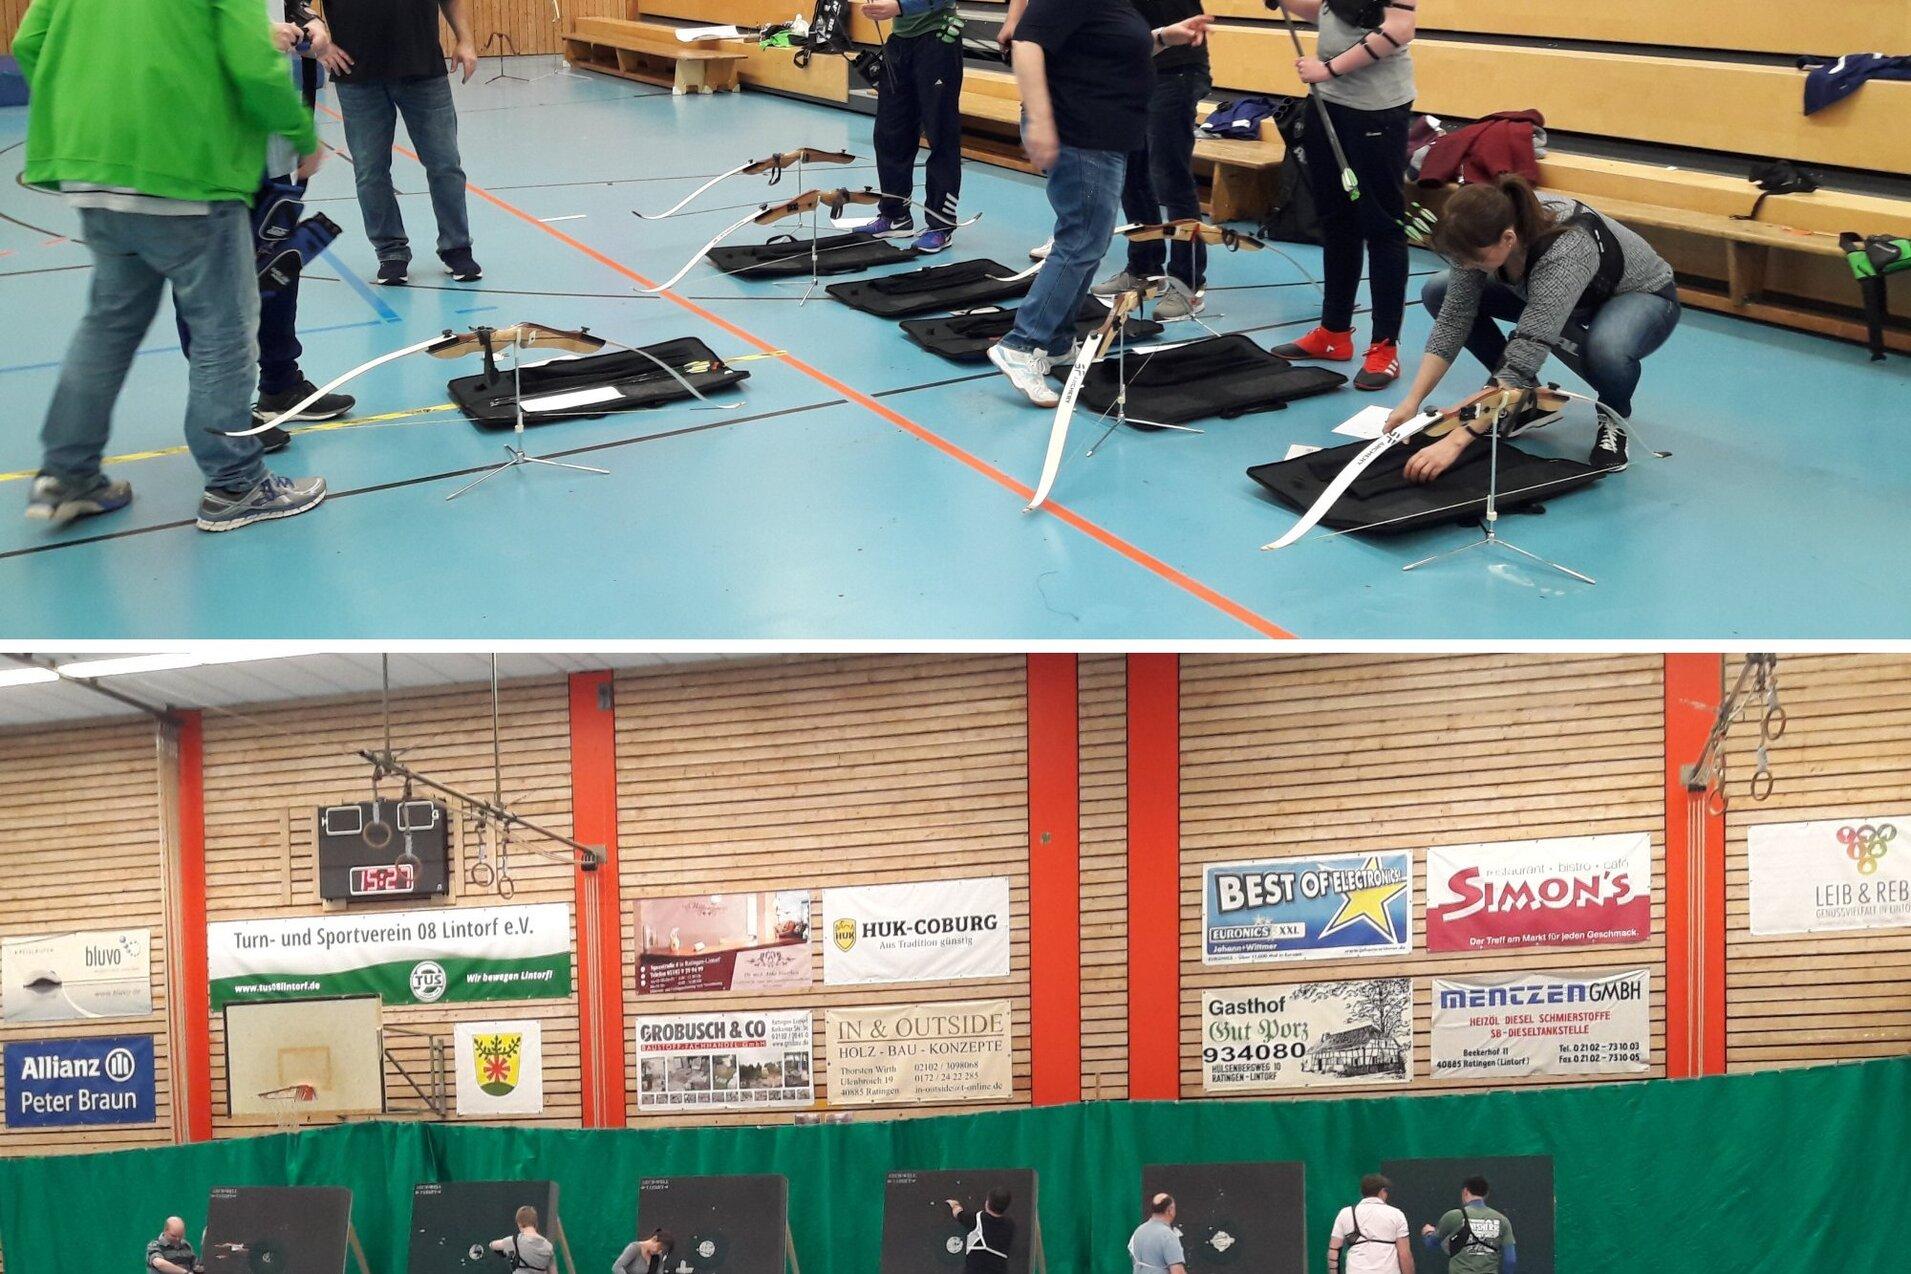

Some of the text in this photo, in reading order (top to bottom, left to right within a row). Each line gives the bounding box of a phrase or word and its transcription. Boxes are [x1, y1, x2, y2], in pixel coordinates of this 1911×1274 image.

[1558, 862, 1592, 873] bistro
[361, 867, 411, 892] 15:27
[1216, 872, 1296, 914] BEST
[1301, 870, 1330, 899] OF
[1816, 883, 1852, 907] LEIB
[1858, 882, 1871, 904] &
[234, 916, 534, 950] Turn- und Sportverein 08 Lintorf e.V.
[862, 914, 998, 938] HUK-COBURG
[1212, 924, 1300, 941] EURONICS XXL
[835, 930, 855, 941] HUK
[879, 936, 973, 950] Aus Tradition günstig
[1469, 937, 1485, 946] Der
[1486, 935, 1505, 944] Treff
[1522, 934, 1547, 943] Markt
[1548, 933, 1560, 941] für
[1561, 931, 1585, 942] jeden
[85, 944, 122, 967] bluvo
[415, 974, 442, 986] TUS
[467, 973, 482, 983] Wir
[483, 972, 520, 983] bewegen
[235, 981, 321, 993] www.tus08lintorf.de
[1589, 980, 1641, 1002] GMBH
[1209, 996, 1286, 1016] Gasthof
[1505, 1014, 1534, 1025] DIESEL
[1539, 1010, 1611, 1023] SCHMIERSTOFFE
[640, 1020, 766, 1042] GROBUSCH & CO
[839, 1013, 1003, 1040] IN & OUTSIDE
[1209, 1021, 1252, 1042] Gut
[839, 1046, 876, 1059] HOLZ
[888, 1044, 917, 1056] BAU
[929, 1040, 1003, 1055] KONZEPTE
[1203, 1042, 1306, 1063] 934080
[1463, 1047, 1500, 1057] Beekerhof
[1559, 1044, 1572, 1052] Tel.
[21, 1055, 101, 1080] Allianz
[914, 1063, 938, 1071] 02102
[1436, 1057, 1530, 1069] 40885 Ratingen (Lintorf)
[841, 1067, 873, 1076] Thorsten
[914, 1073, 933, 1082] 0172
[885, 1076, 894, 1084] 19
[866, 1088, 900, 1097] Ratingen
[21, 1089, 137, 1114] Peter Braun
